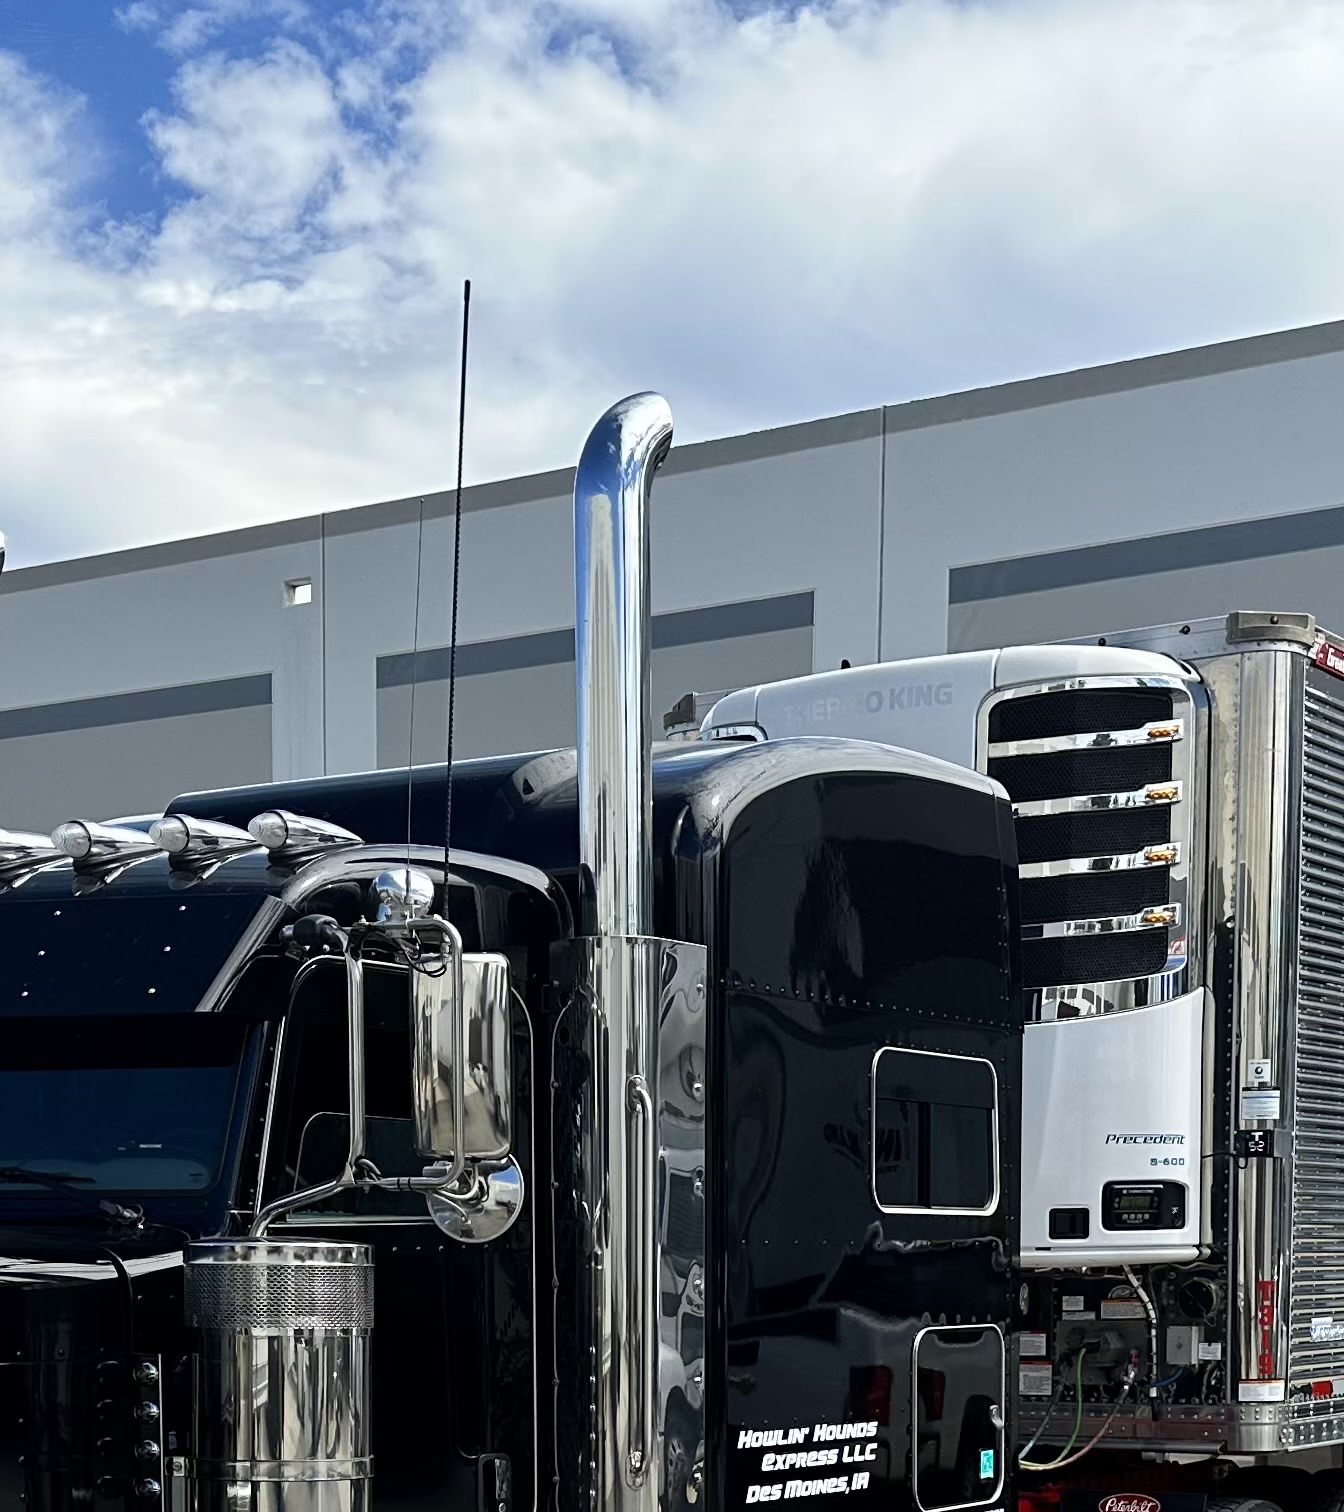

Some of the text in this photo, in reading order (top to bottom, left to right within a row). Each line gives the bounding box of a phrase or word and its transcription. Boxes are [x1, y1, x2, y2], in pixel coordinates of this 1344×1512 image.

[889, 683, 953, 711] KING
[1105, 1133, 1186, 1145] Precedent
[842, 1443, 878, 1463] LLC
